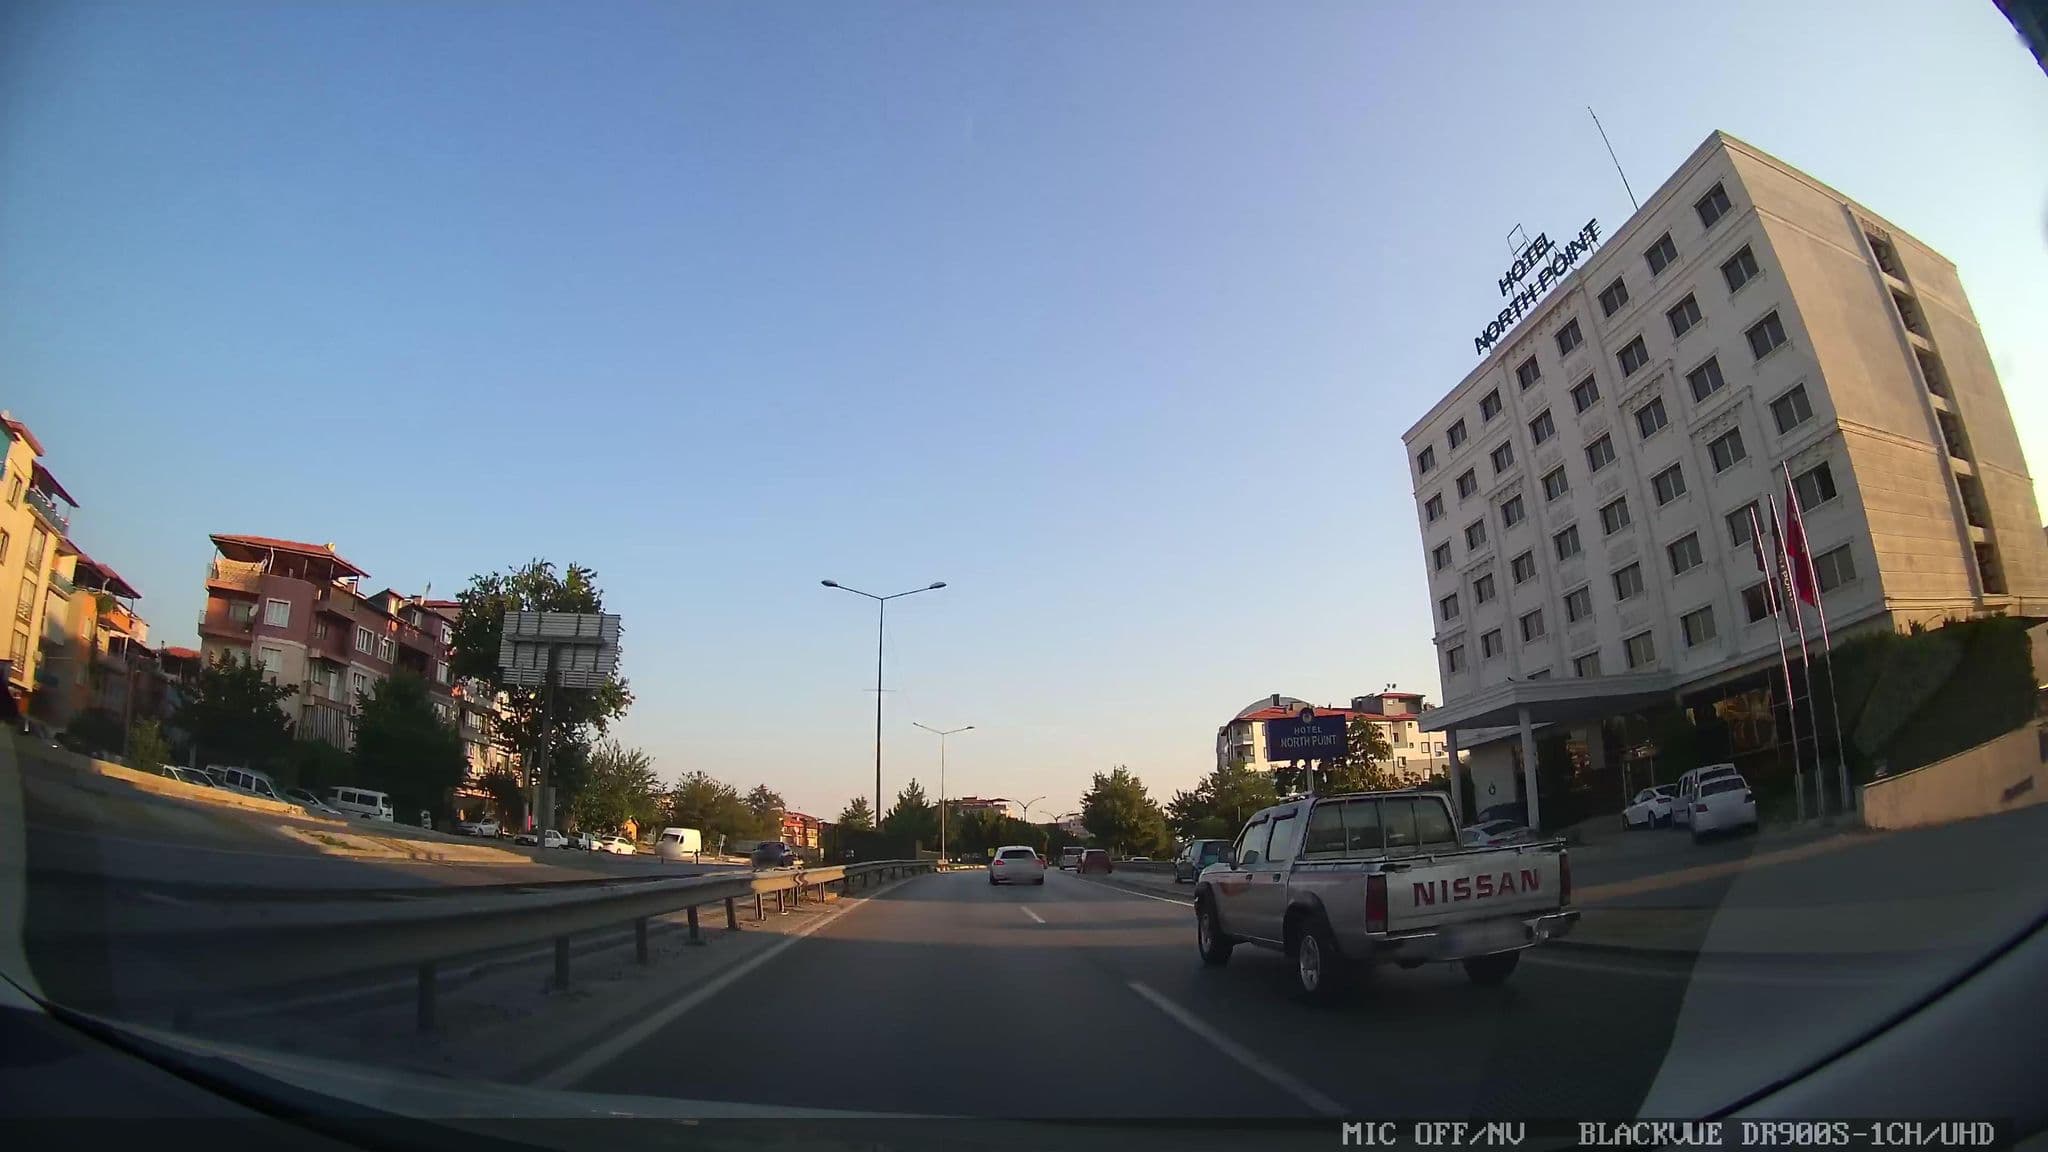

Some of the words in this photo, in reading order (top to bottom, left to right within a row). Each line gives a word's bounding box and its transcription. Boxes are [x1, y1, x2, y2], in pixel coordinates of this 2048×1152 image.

[1498, 232, 1555, 297] HOTEL
[1474, 283, 1538, 356] NORTH
[1537, 218, 1600, 293] POINT
[1281, 737, 1310, 748] NORTH
[1312, 735, 1336, 747] POINT
[1294, 726, 1323, 734] HOTEL
[1412, 868, 1542, 908] NISSAN
